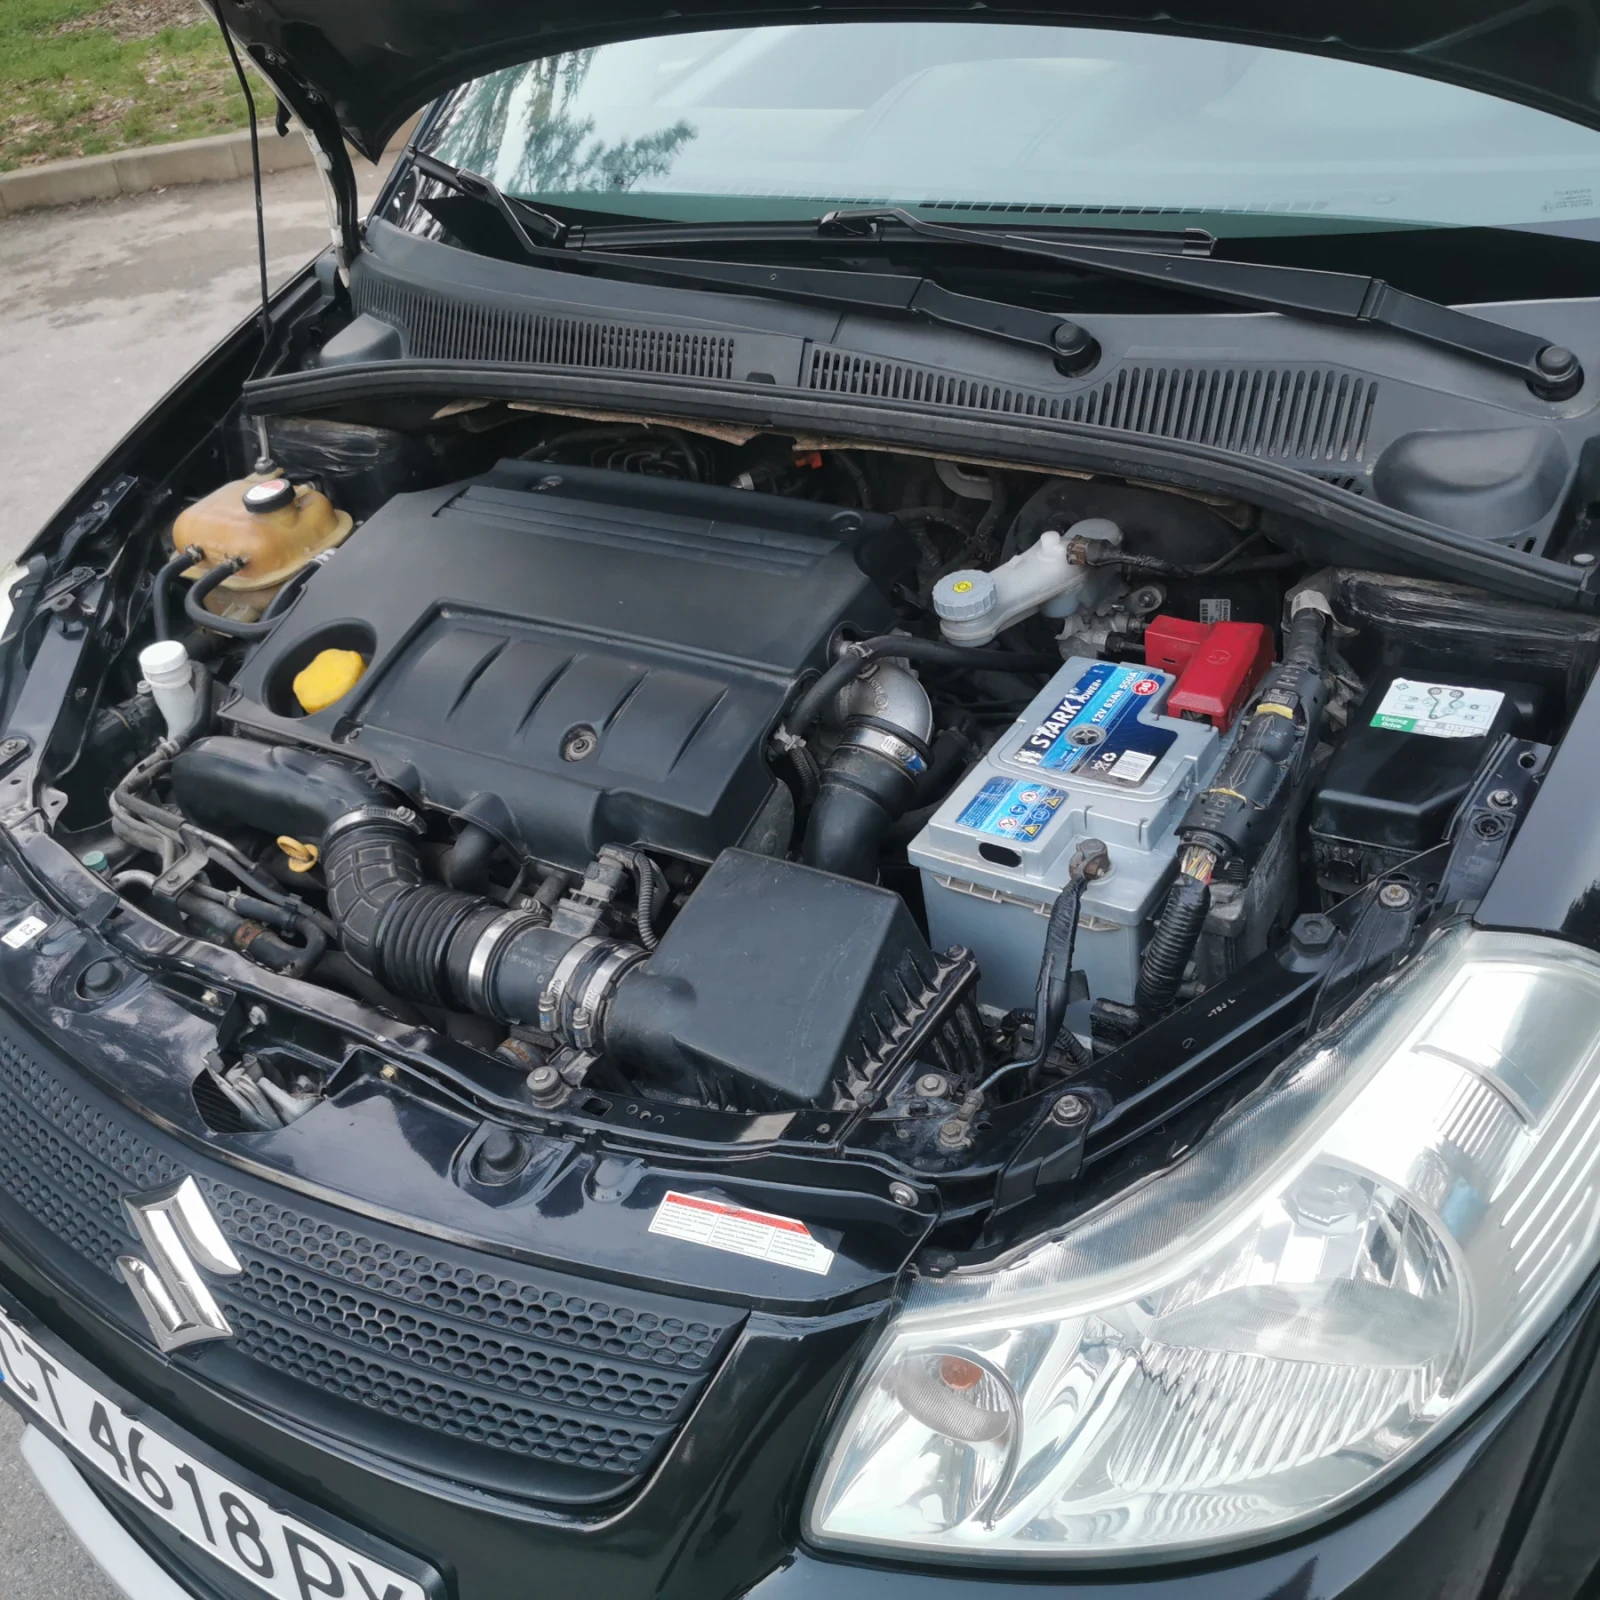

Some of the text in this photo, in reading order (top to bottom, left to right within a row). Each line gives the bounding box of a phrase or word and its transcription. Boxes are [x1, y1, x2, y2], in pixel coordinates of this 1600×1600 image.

[1091, 672, 1138, 723] 12V 63Ah 550A
[1138, 682, 1152, 693] 30
[1031, 700, 1082, 749] STARK
[1381, 715, 1408, 725] Timing
[1381, 721, 1402, 729] Drive
[0, 1319, 68, 1431] CT
[89, 1400, 275, 1579] 4618
